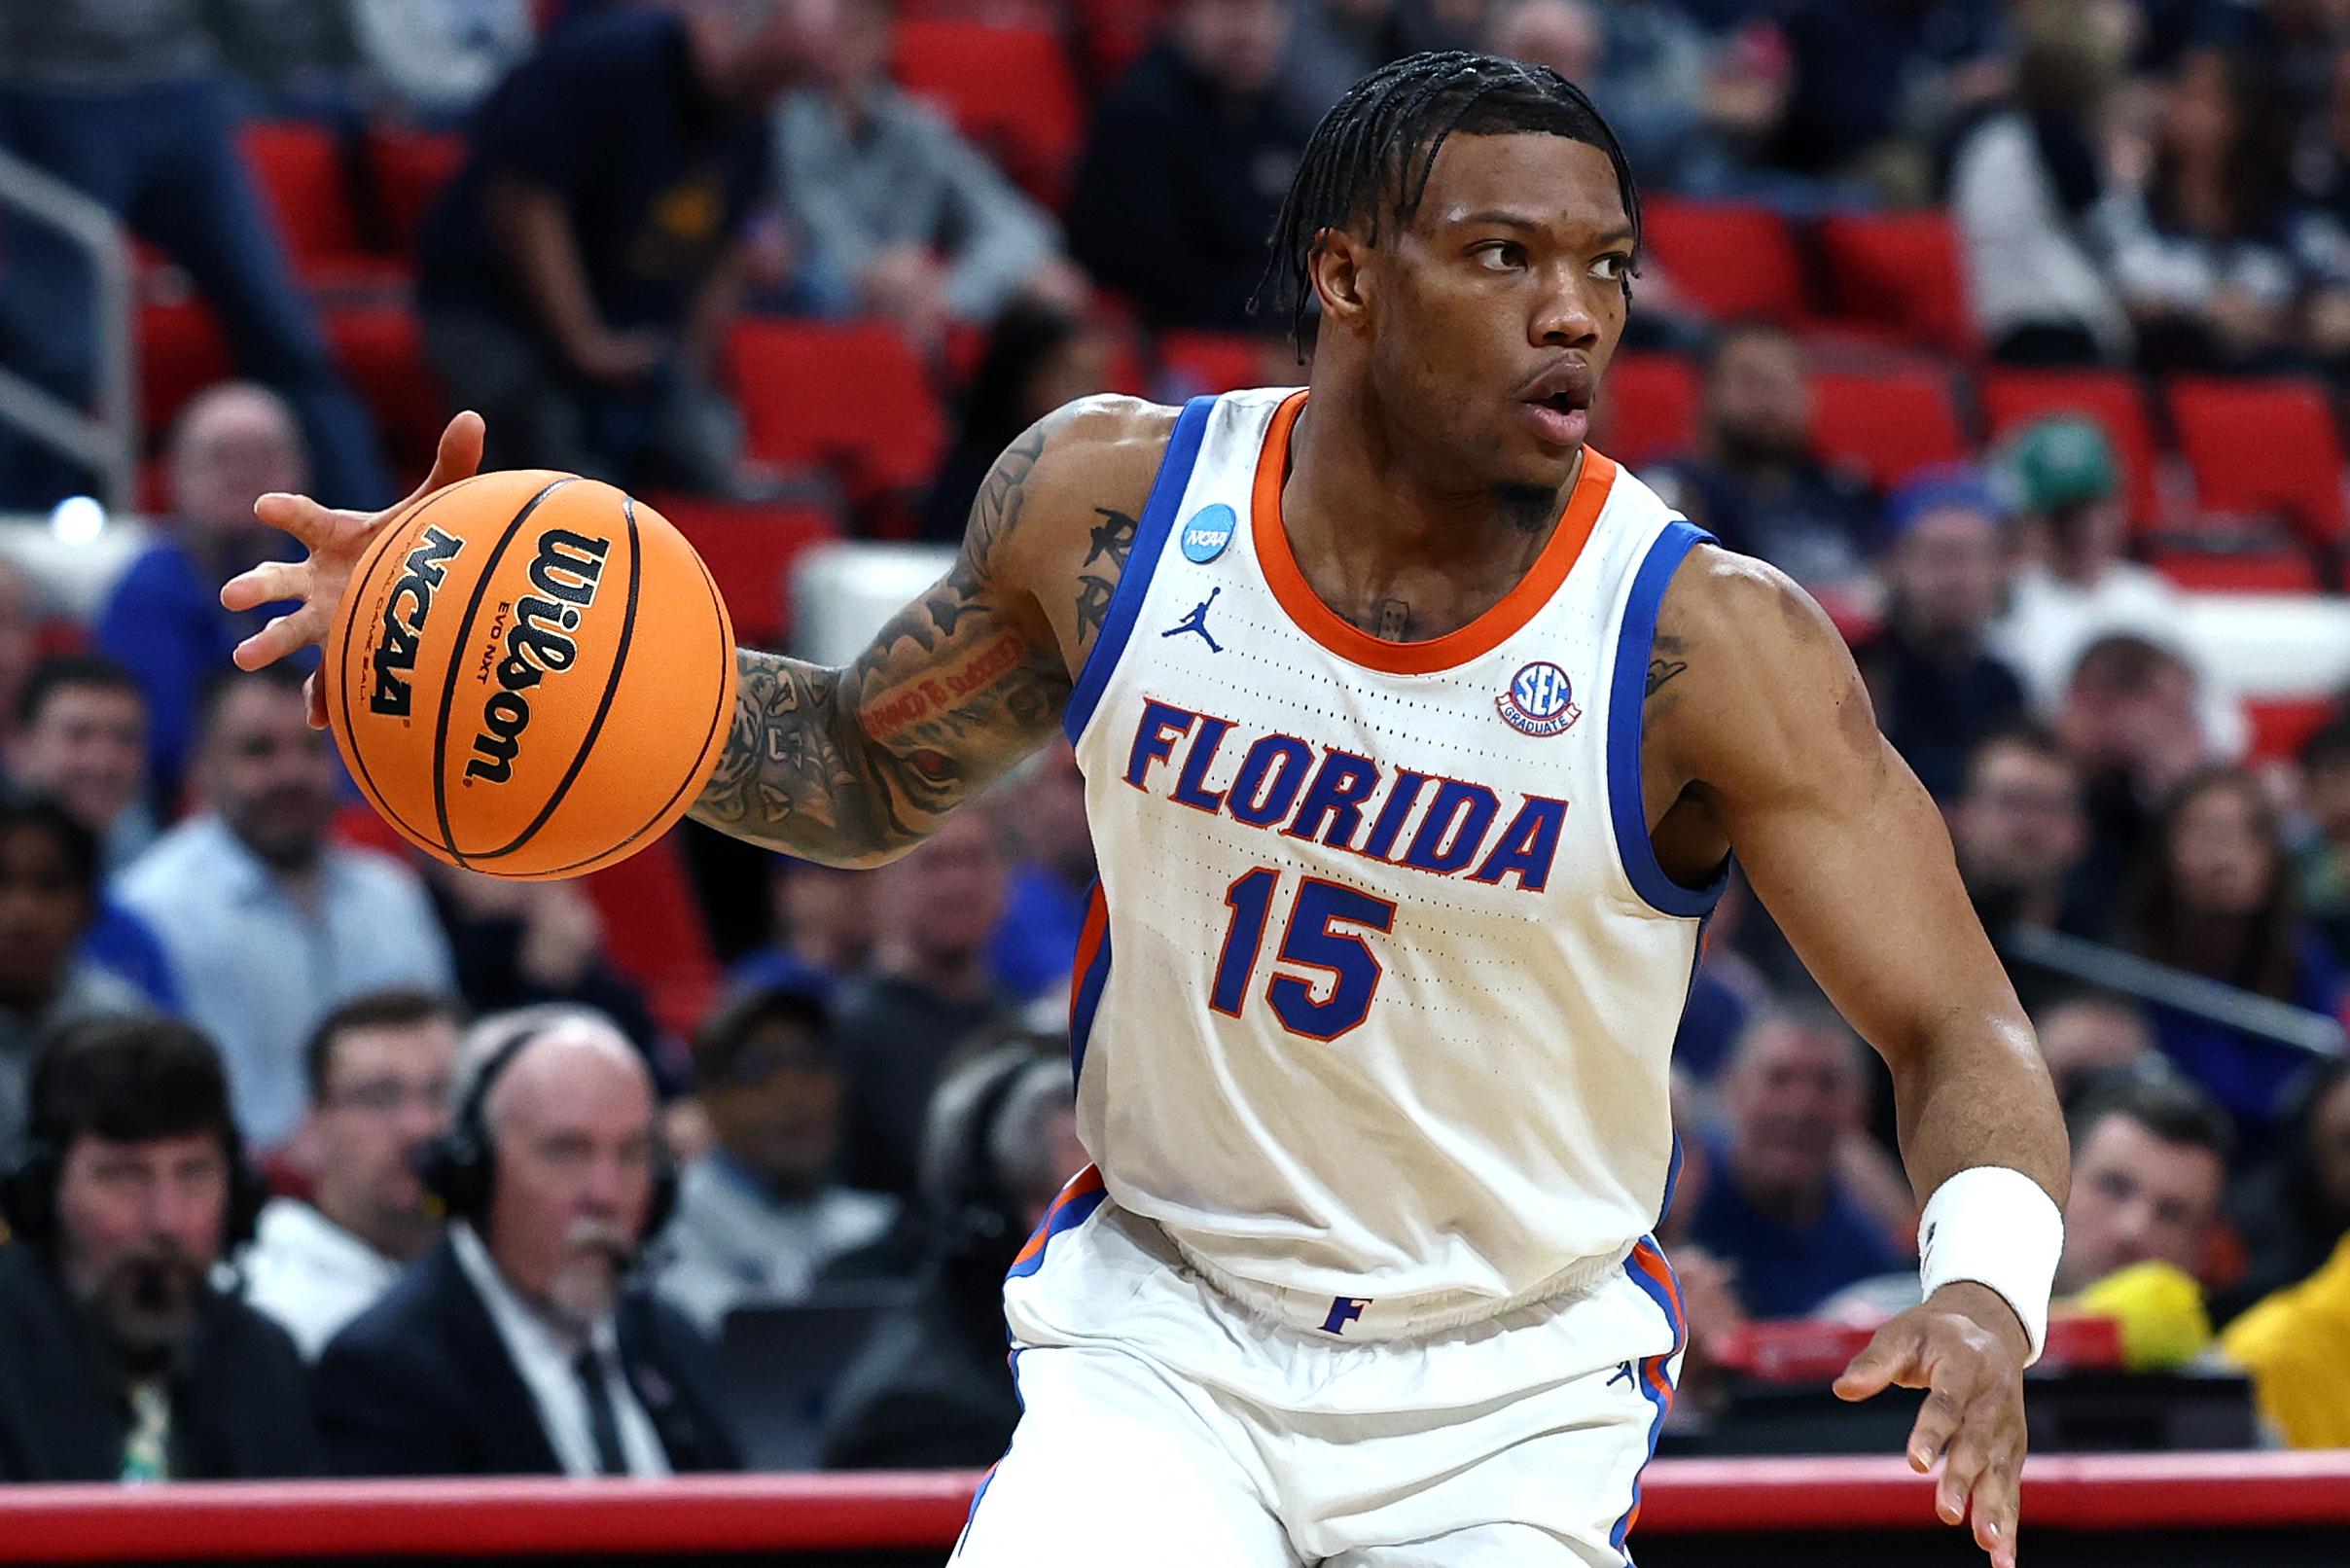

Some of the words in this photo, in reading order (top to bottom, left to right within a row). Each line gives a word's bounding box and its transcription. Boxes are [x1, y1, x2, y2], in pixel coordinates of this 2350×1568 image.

[1185, 529, 1229, 547] NCAA
[370, 523, 466, 717] NCAA
[489, 601, 511, 639] EVO
[465, 528, 611, 785] Wilson
[476, 644, 497, 685] NXT
[1514, 664, 1569, 716] SEC
[1504, 706, 1568, 734] GRADUATE
[1122, 695, 1569, 894] FLORIDA
[1208, 866, 1398, 1043] 15
[1317, 1296, 1373, 1336] F
